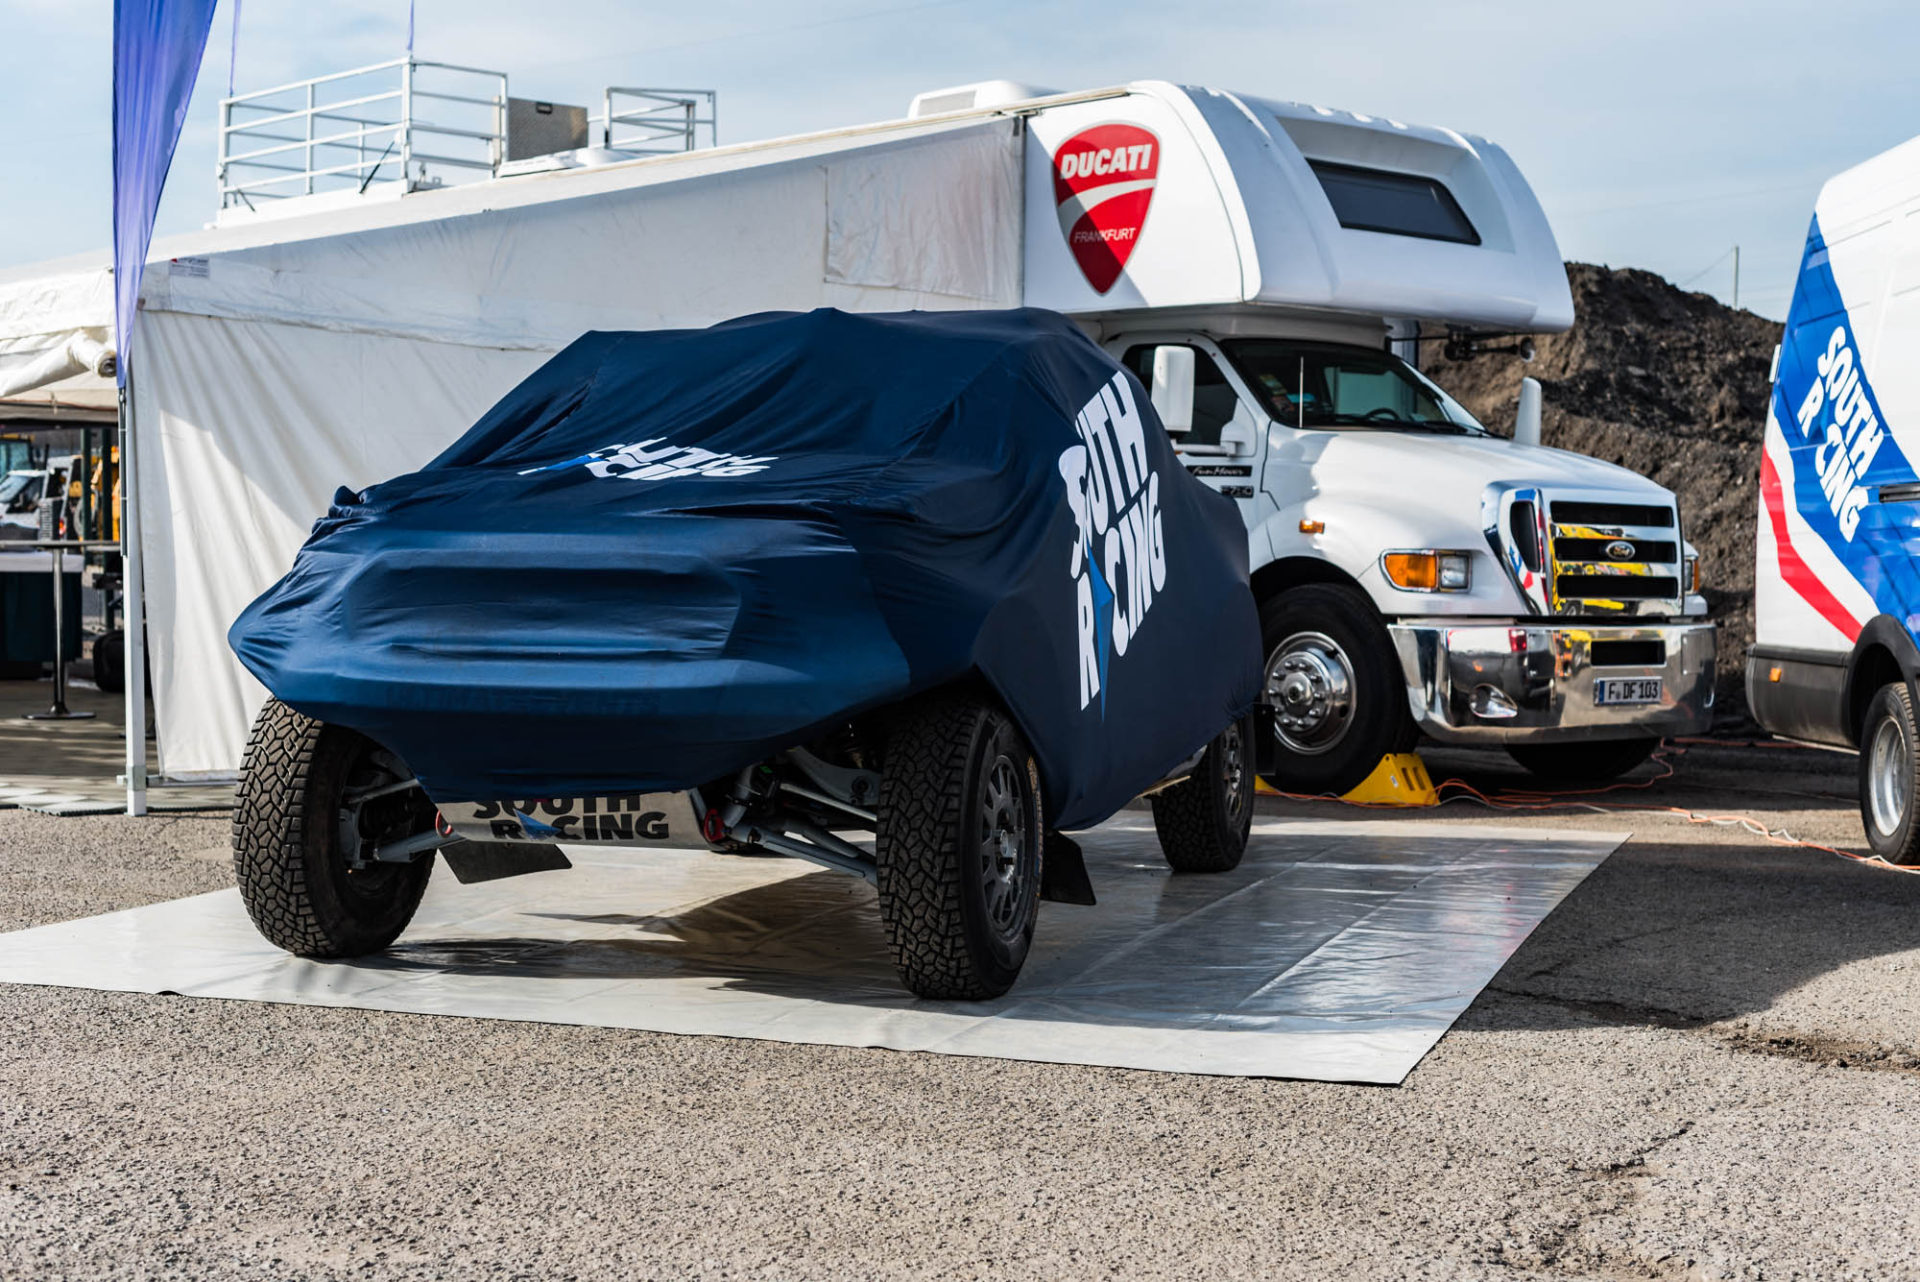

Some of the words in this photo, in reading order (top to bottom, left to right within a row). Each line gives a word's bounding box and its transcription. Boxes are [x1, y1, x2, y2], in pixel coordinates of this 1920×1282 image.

[1060, 144, 1152, 180] DUCATI
[1074, 227, 1136, 242] FRANKFURT
[1817, 325, 1884, 480] SOUTH
[1608, 682, 1616, 699] F
[1639, 682, 1659, 699] 103
